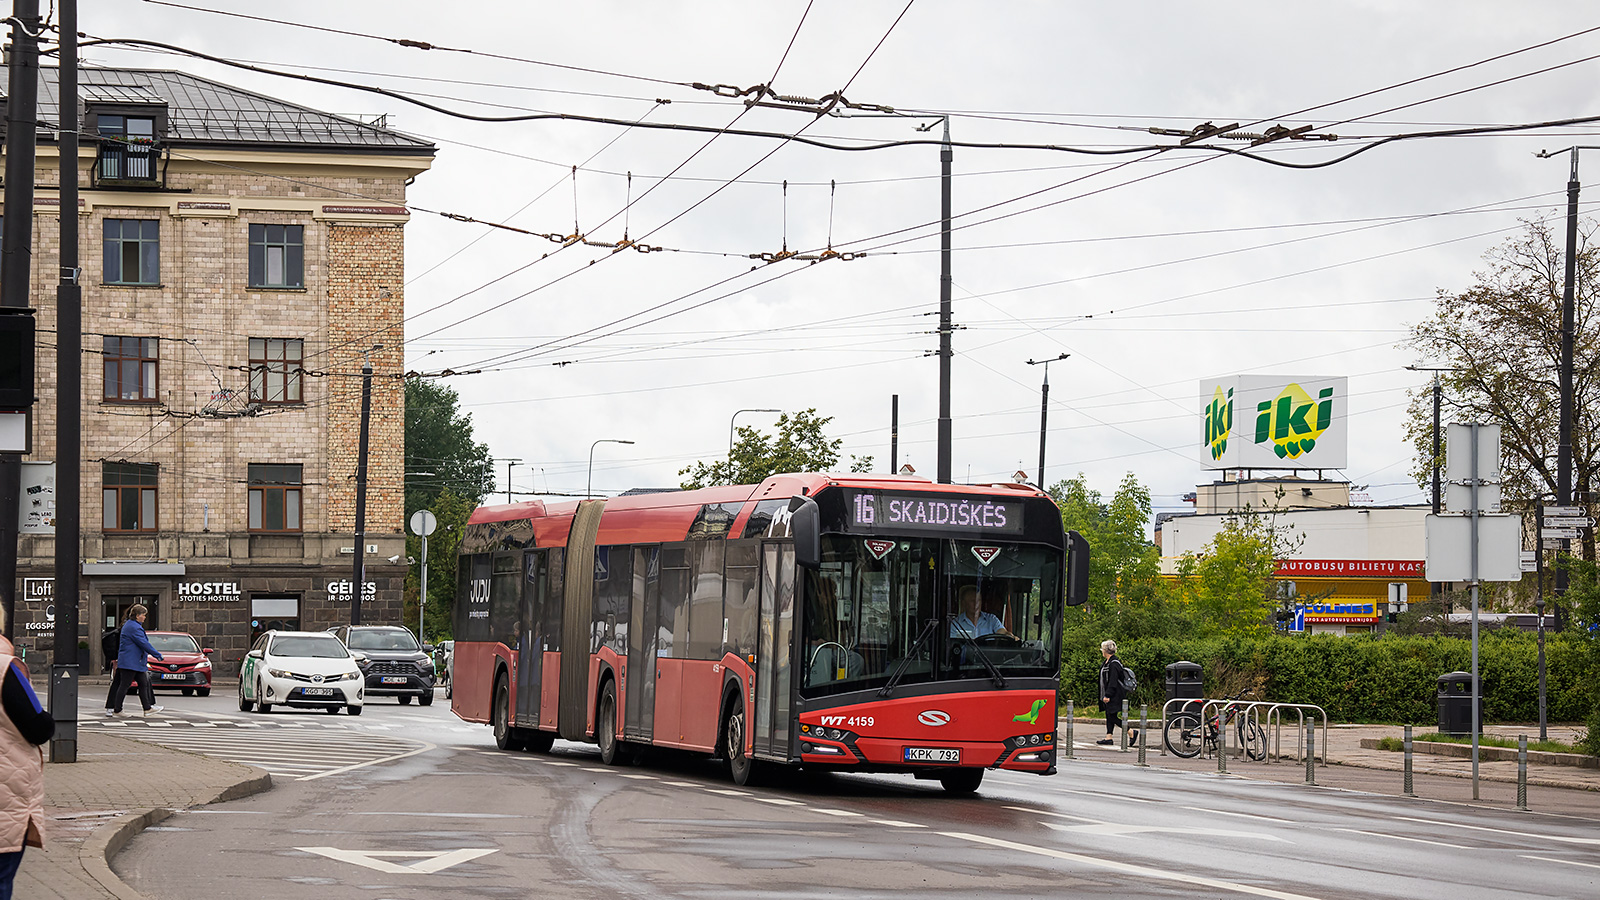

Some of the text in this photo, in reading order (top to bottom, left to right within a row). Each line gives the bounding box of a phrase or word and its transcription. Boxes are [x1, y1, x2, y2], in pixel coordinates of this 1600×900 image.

[1205, 387, 1233, 447] iki
[1255, 387, 1333, 444] iki
[854, 494, 1006, 527] 16 SKAIDIŠKĖS
[1281, 562, 1425, 572] AUTOBUSŲ BILIETŲ KAS
[32, 581, 51, 596] Loft
[178, 582, 241, 595] HOSTEL
[1297, 603, 1374, 614] COLINES
[821, 716, 874, 726] VVT 4159
[911, 750, 958, 760] KPK 792
